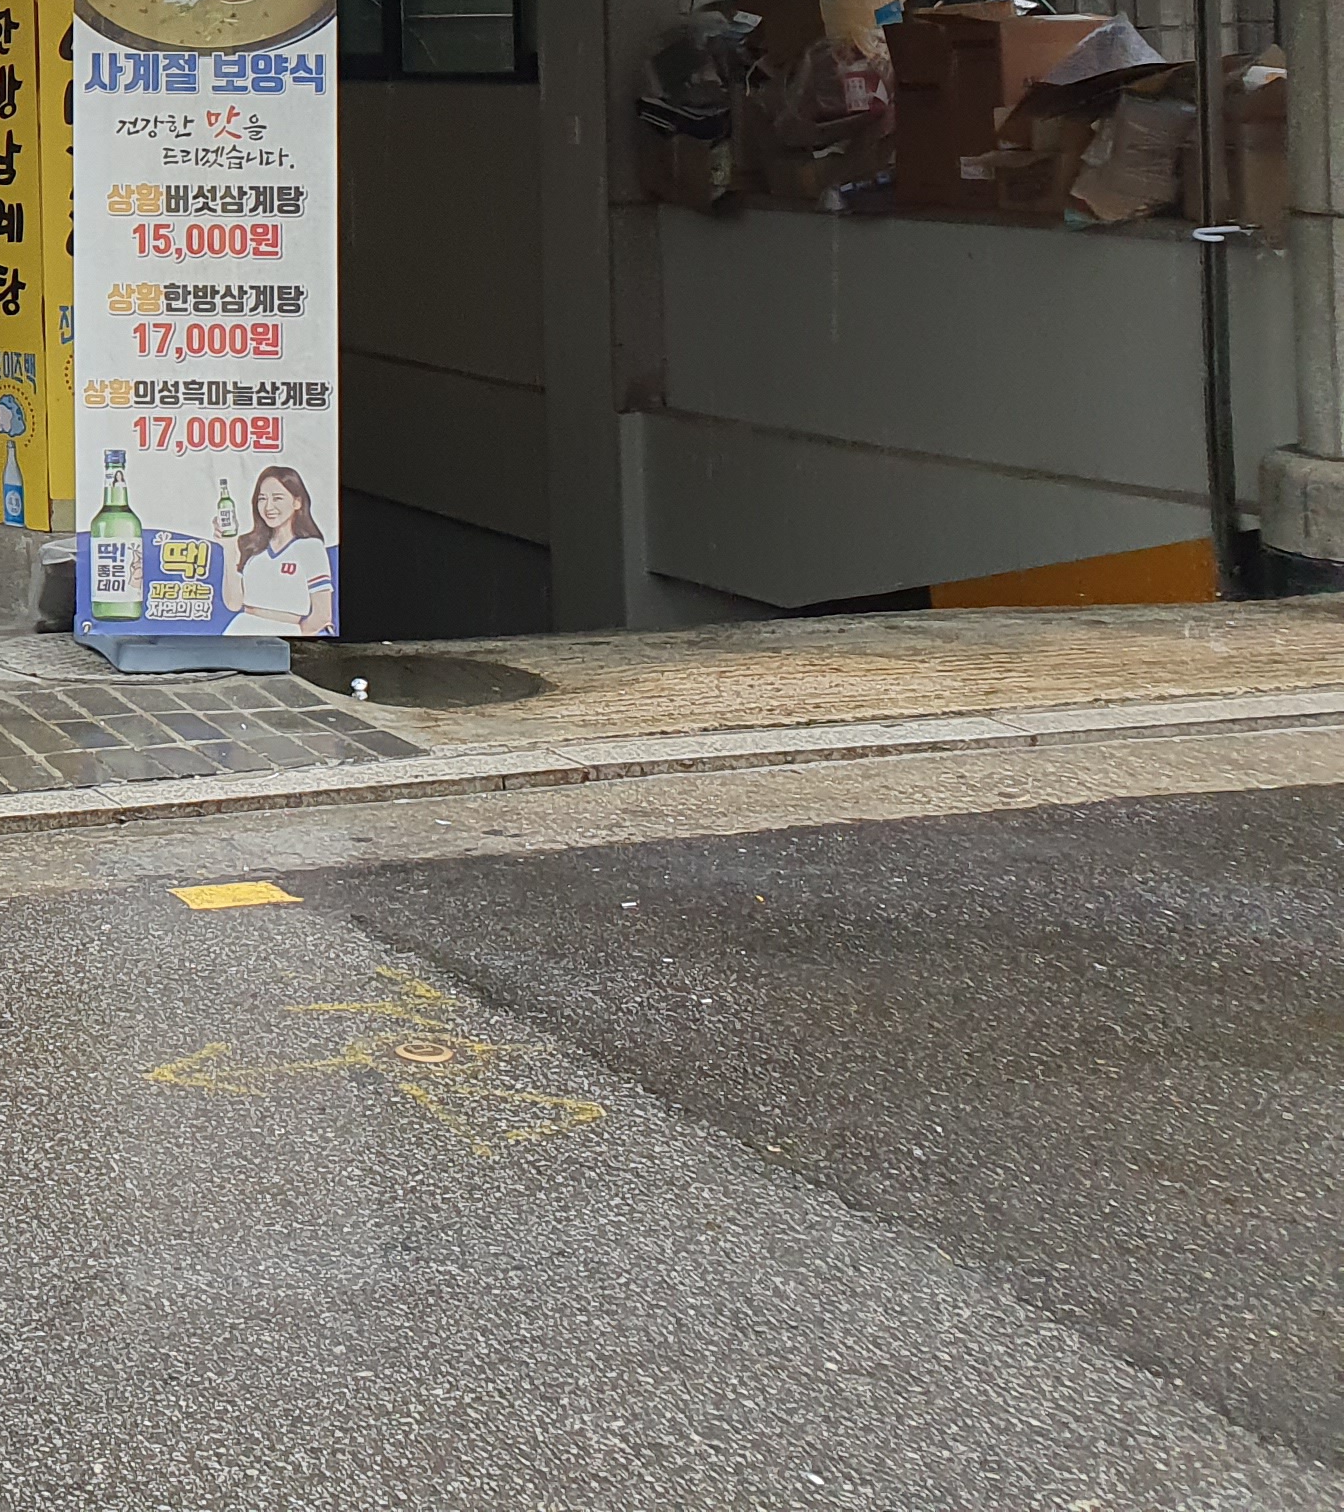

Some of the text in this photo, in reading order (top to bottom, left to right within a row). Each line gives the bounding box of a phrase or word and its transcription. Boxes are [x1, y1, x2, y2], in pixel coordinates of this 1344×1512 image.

[84, 51, 327, 94] 사계절 보양식
[115, 105, 268, 142] 건강한 맛을
[107, 183, 307, 217] 상황버섯삼계탕
[131, 223, 283, 260] 15,000원
[107, 283, 307, 316] 상황한방삼계탕
[132, 322, 283, 361] 17,000원
[83, 379, 331, 409] 상황의성흑마늘삼계탕
[132, 415, 283, 455] 17,000원
[97, 579, 126, 592] 데이
